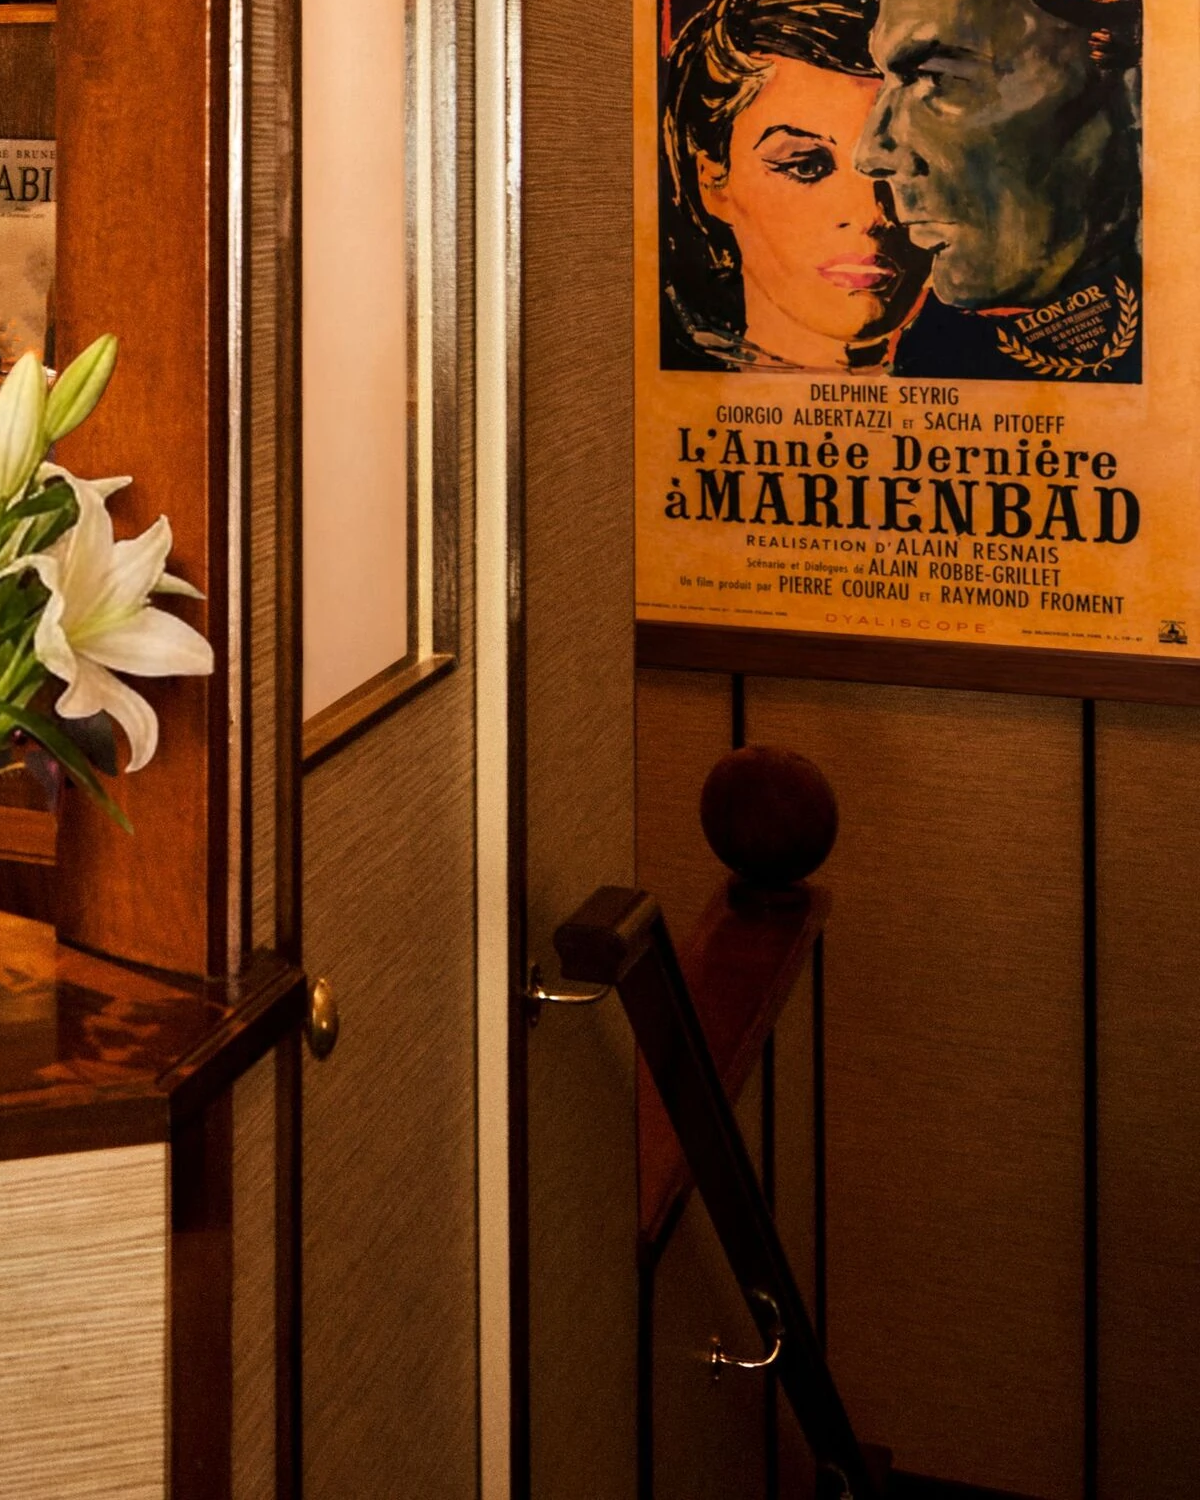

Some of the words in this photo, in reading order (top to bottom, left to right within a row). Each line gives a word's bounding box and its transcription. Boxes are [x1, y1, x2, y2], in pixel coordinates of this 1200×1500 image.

[1014, 301, 1065, 333] LION
[1075, 339, 1099, 354] 1961
[811, 384, 888, 403] DELPHINE
[899, 386, 959, 405] SEYRIG
[717, 405, 782, 425] GIORGIO
[794, 408, 891, 429] ALBERTAZZI
[903, 420, 913, 429] ET
[925, 412, 981, 431] SACHA
[994, 414, 1064, 434] PITOEFF
[678, 427, 869, 470] L'Année
[892, 434, 1117, 480] Dernière
[665, 477, 690, 520] à
[696, 468, 1140, 544] MARIENBAD
[747, 535, 867, 552] REALISATION
[896, 538, 958, 558] ALAIN
[973, 543, 1059, 564] RESNAIS
[747, 558, 785, 569] Scénario
[791, 560, 799, 570] et
[805, 561, 848, 575] Dialogues
[869, 559, 918, 578] ALAIN
[930, 562, 1060, 586] ROBBE-GRILLET
[680, 576, 692, 587] Un
[697, 577, 714, 587] film
[719, 579, 751, 592] produit
[757, 582, 771, 592] par
[779, 576, 832, 595] PIERRE
[842, 580, 909, 600] COURAU
[920, 593, 930, 602] ET
[941, 586, 1029, 608] RAYMOND
[1041, 592, 1124, 614] FROMENT
[825, 613, 987, 633] DYALISCOPE
